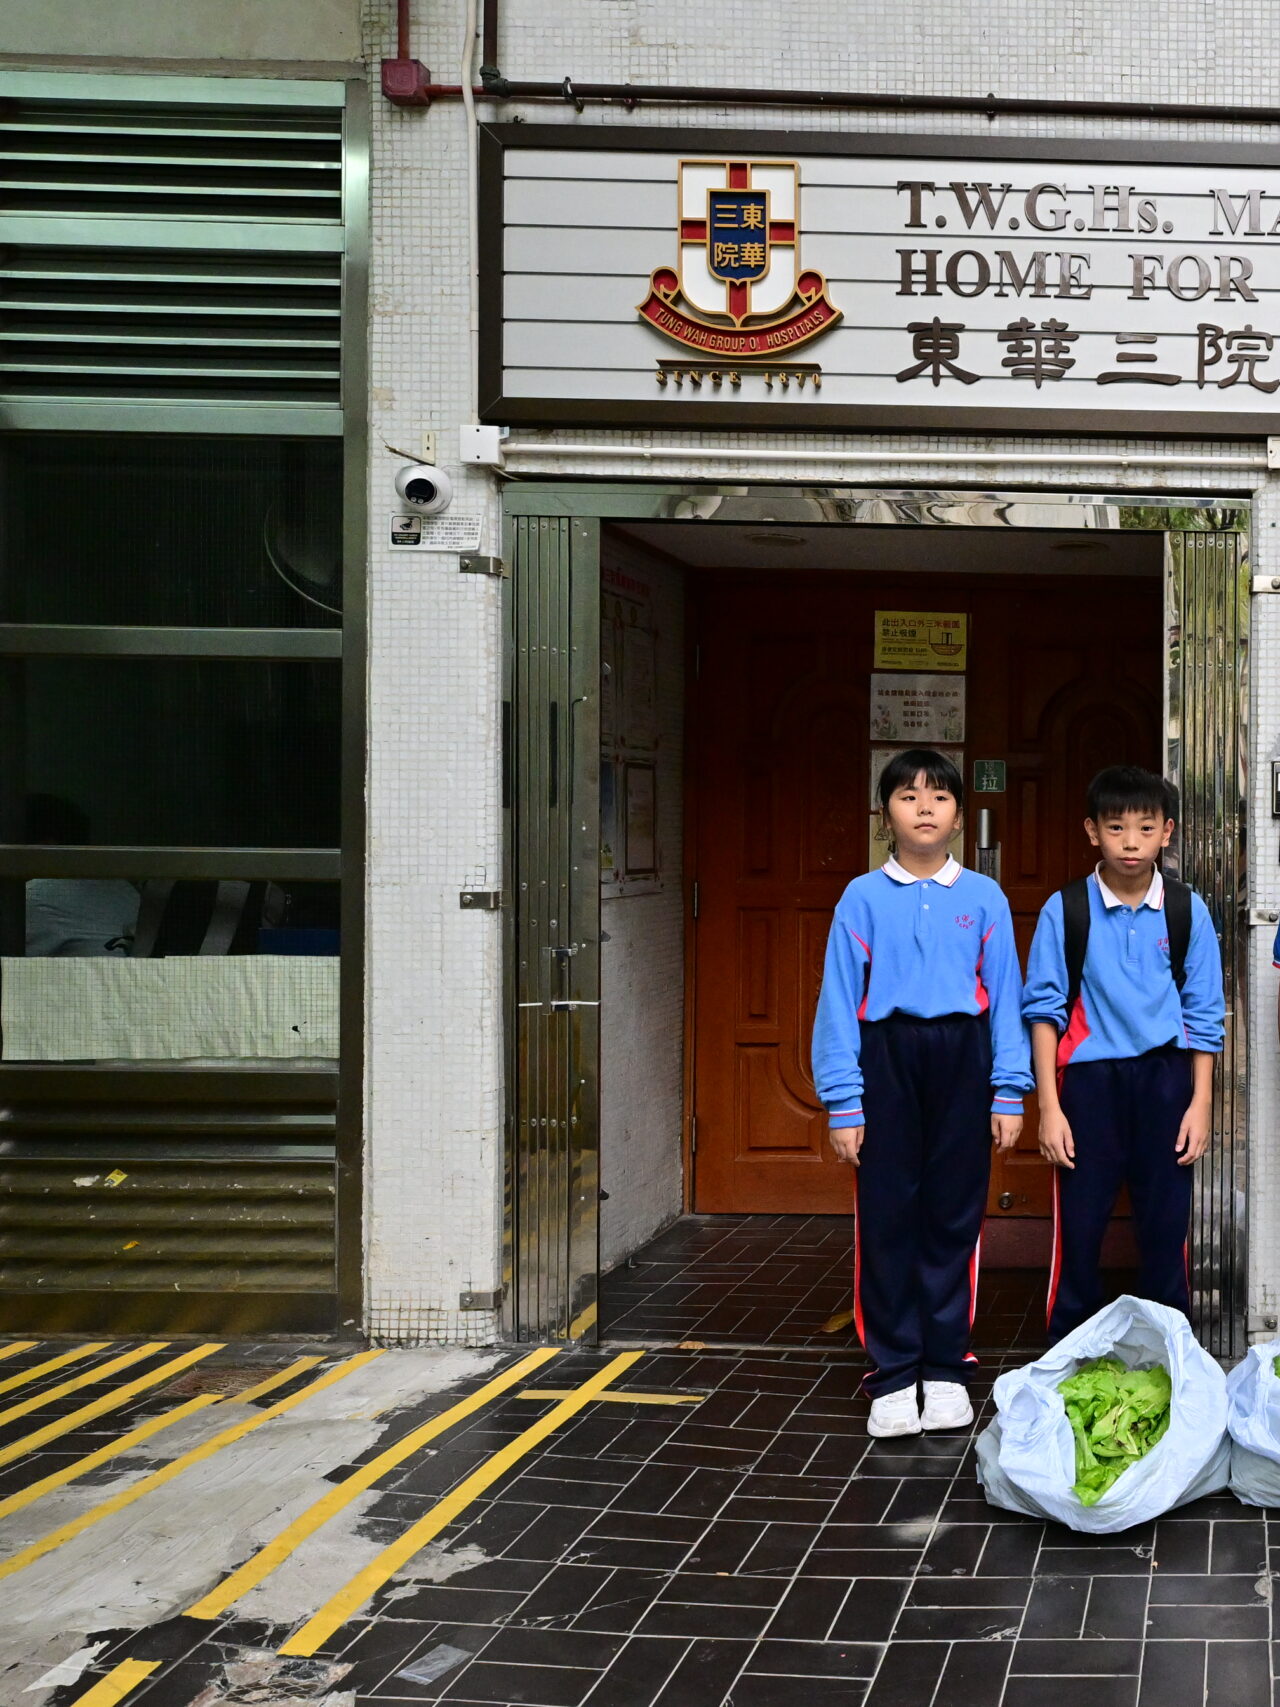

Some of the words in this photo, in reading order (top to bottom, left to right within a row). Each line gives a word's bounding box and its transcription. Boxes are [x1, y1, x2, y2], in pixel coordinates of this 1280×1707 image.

[897, 180, 1174, 234] T.W.G.Hs.
[895, 249, 1093, 299] HOME
[1127, 253, 1259, 302] FOR
[655, 307, 683, 333] TUNG
[683, 324, 708, 345] WAH
[709, 334, 746, 350] GROUP
[766, 310, 824, 347] HOSPITALS
[655, 370, 742, 386] SINCE
[763, 372, 821, 388] 1870
